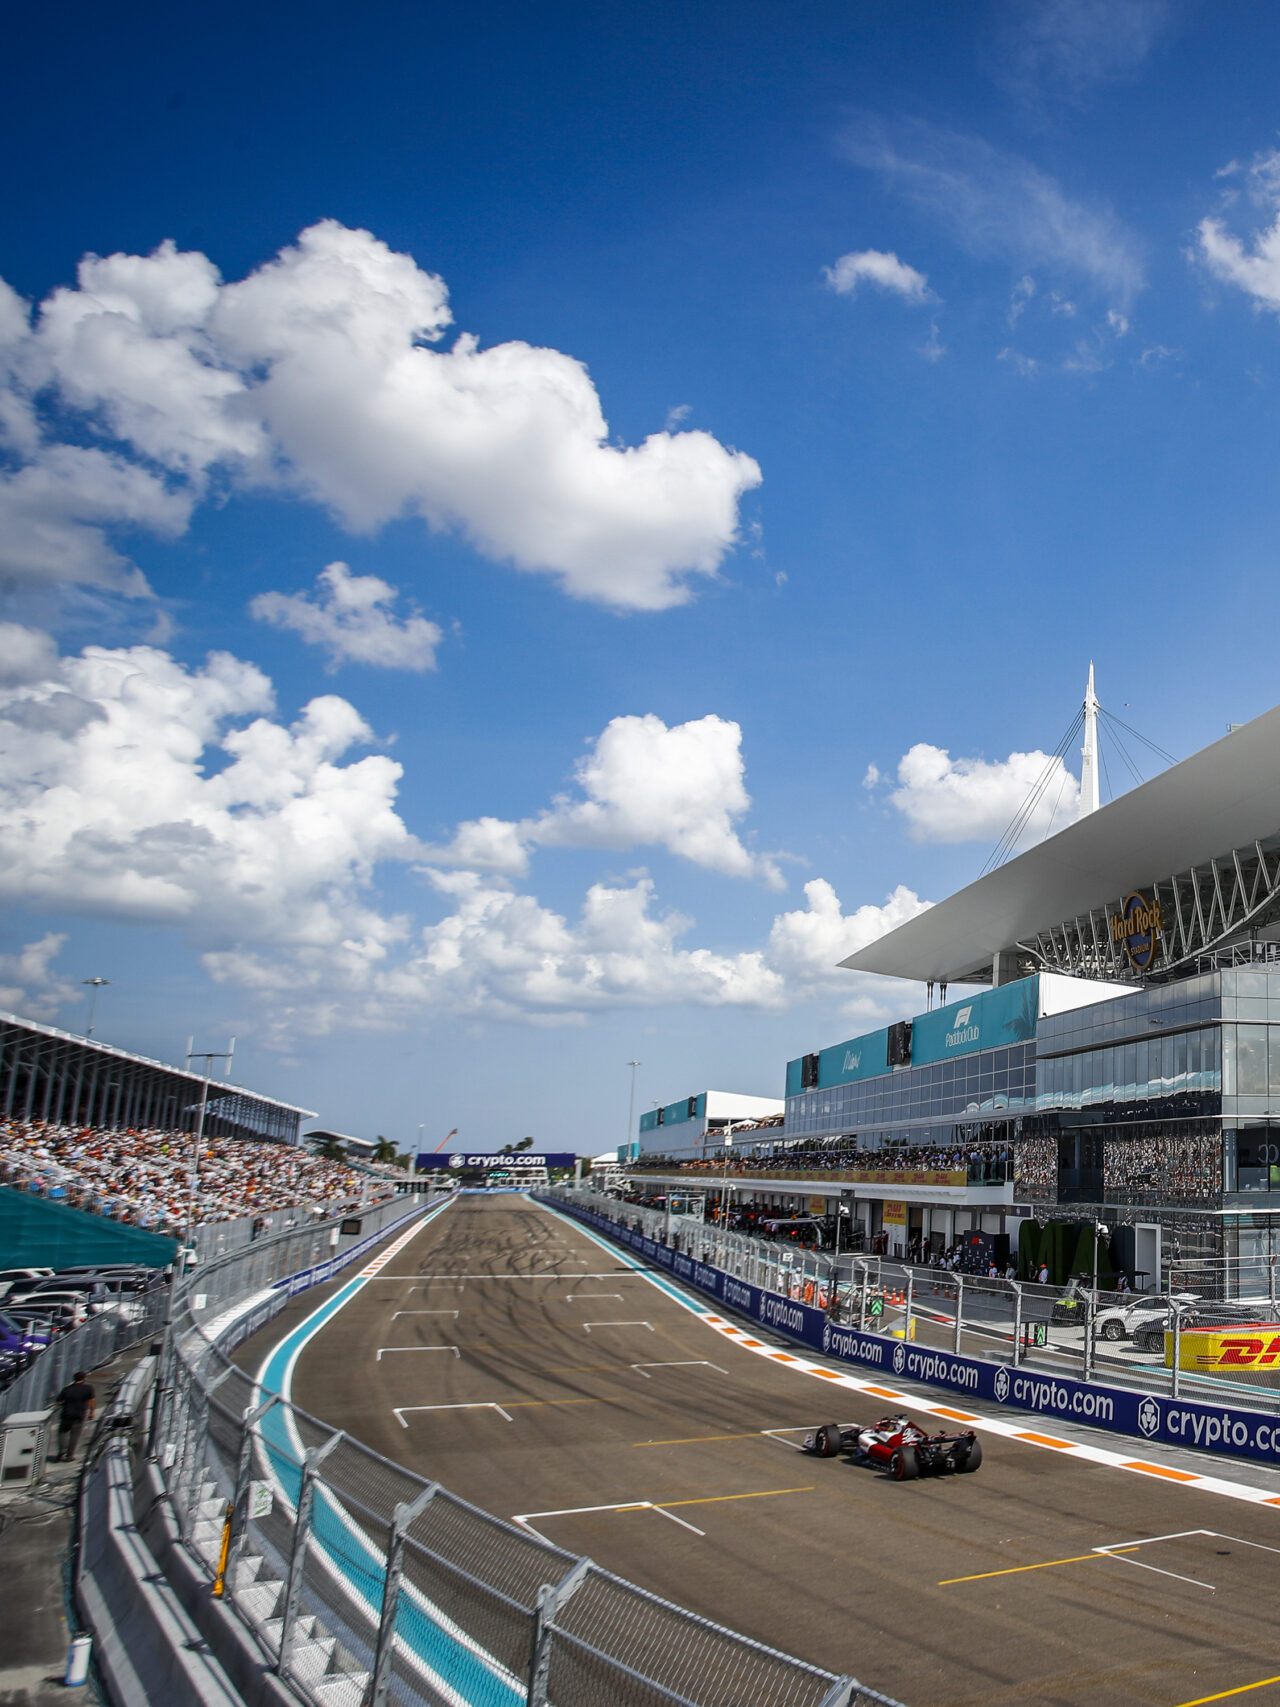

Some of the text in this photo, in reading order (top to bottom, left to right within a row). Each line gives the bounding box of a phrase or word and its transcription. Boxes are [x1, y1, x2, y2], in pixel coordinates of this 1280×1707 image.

[1111, 900, 1163, 941] Hard Rock
[1131, 943, 1150, 956] STADIUM
[467, 1154, 546, 1167] crypto.com
[766, 1299, 804, 1332] crypto.com
[831, 1332, 883, 1363] crypto.com
[907, 1353, 979, 1390] crypto.com
[1014, 1377, 1115, 1421] crypto.com
